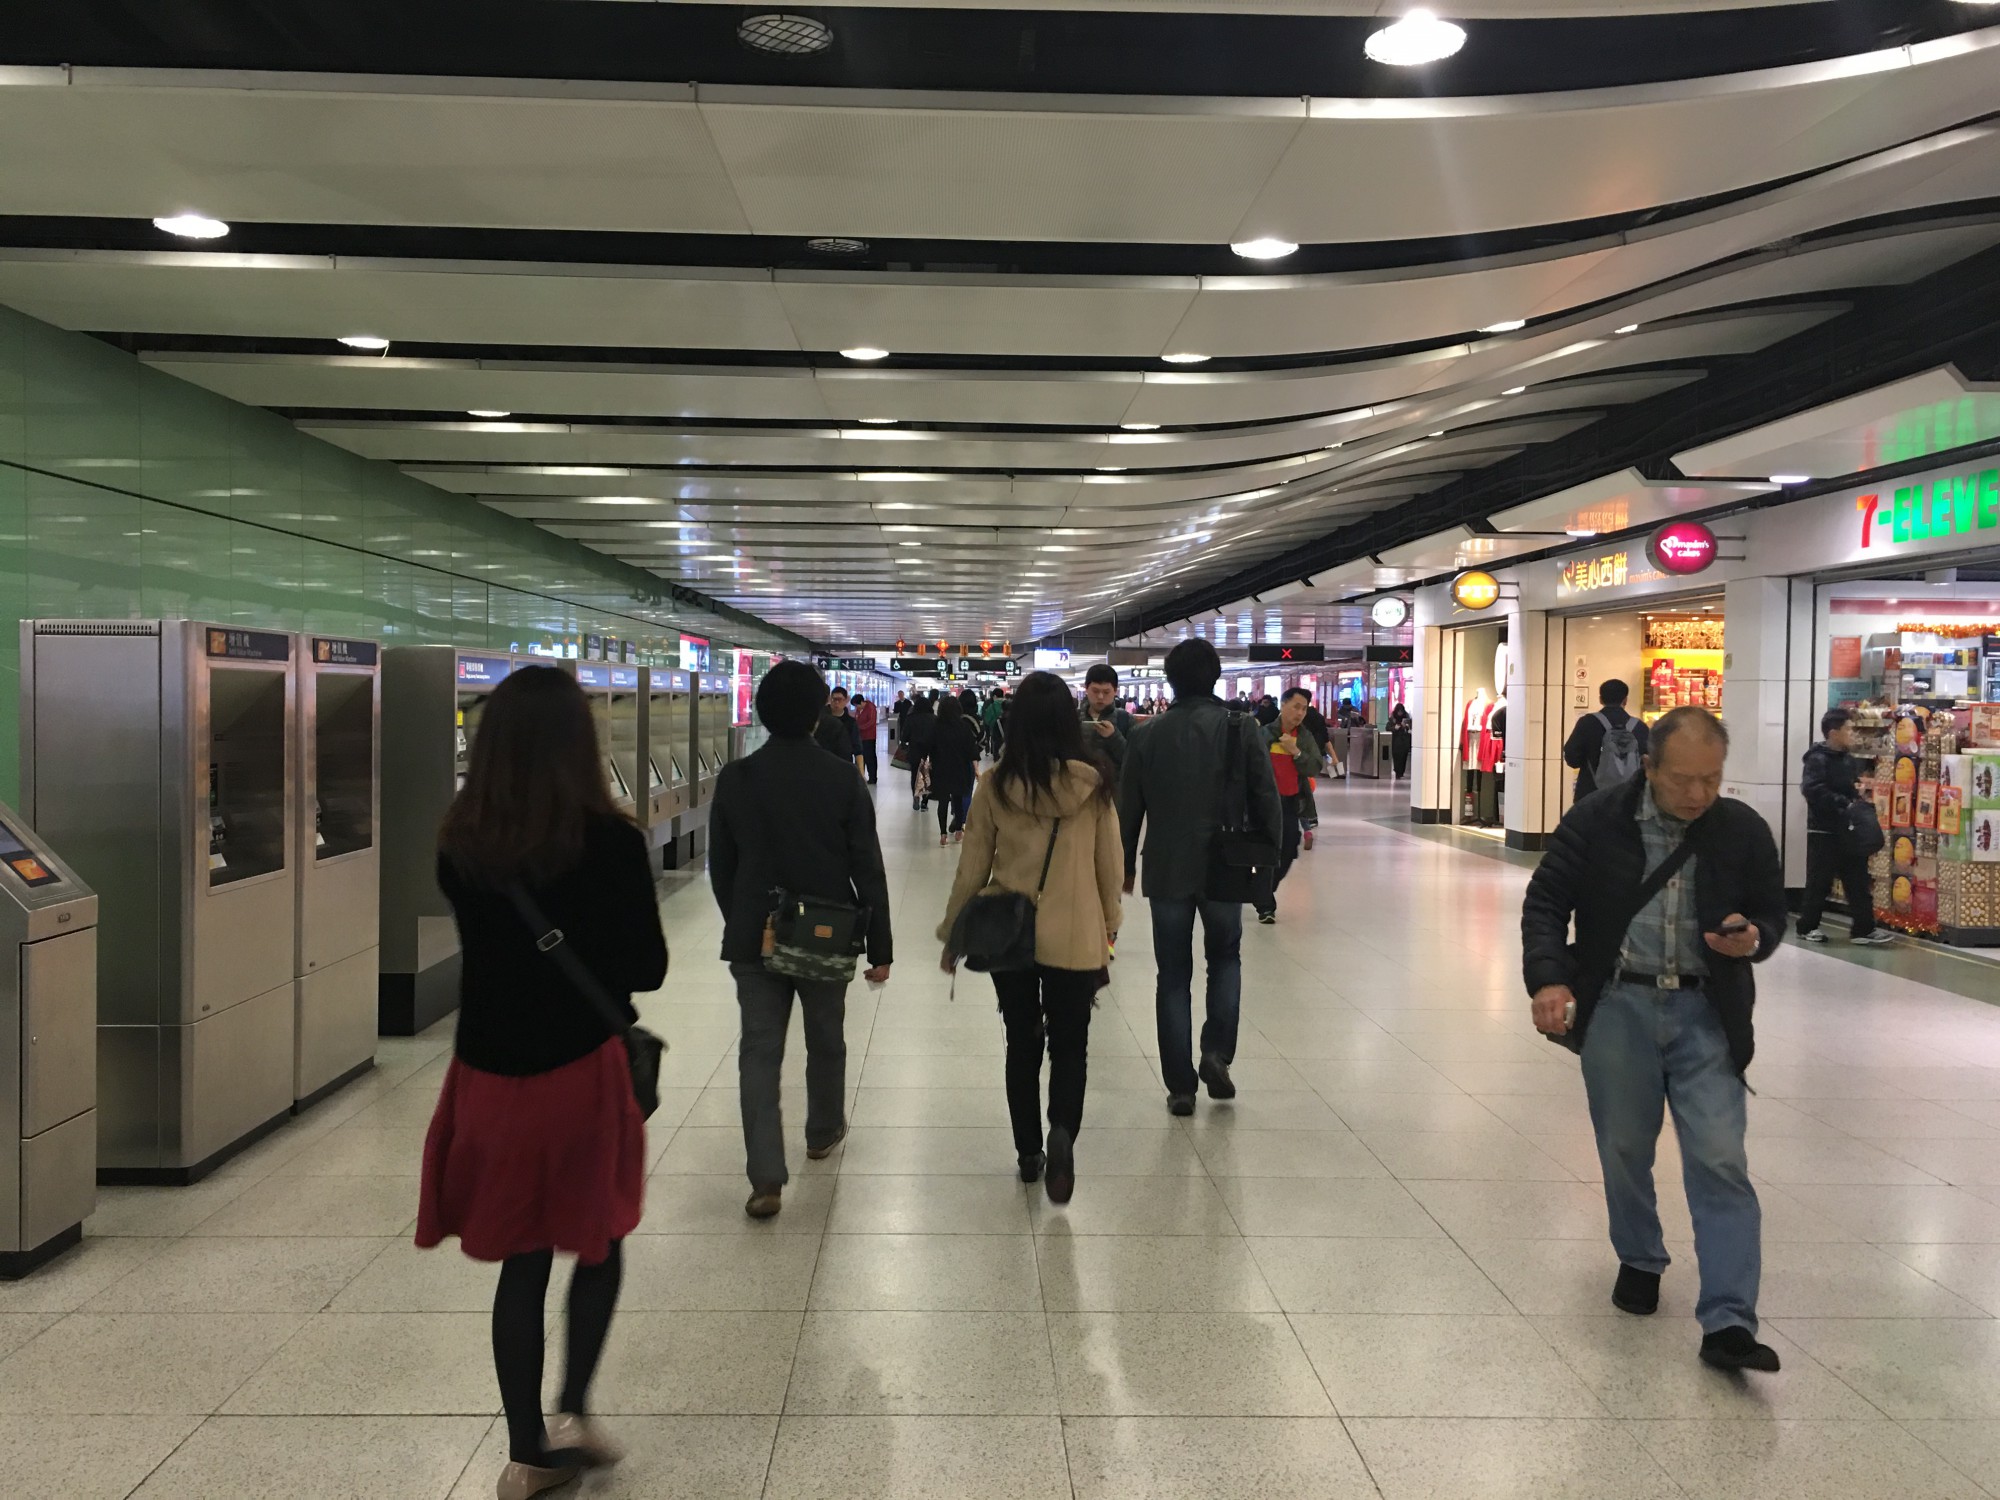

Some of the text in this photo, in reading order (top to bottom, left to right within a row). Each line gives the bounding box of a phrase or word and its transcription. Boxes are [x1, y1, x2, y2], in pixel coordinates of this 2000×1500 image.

[1856, 469, 2000, 549] 7-ELEVE
[1575, 551, 1628, 593] 美心西餅
